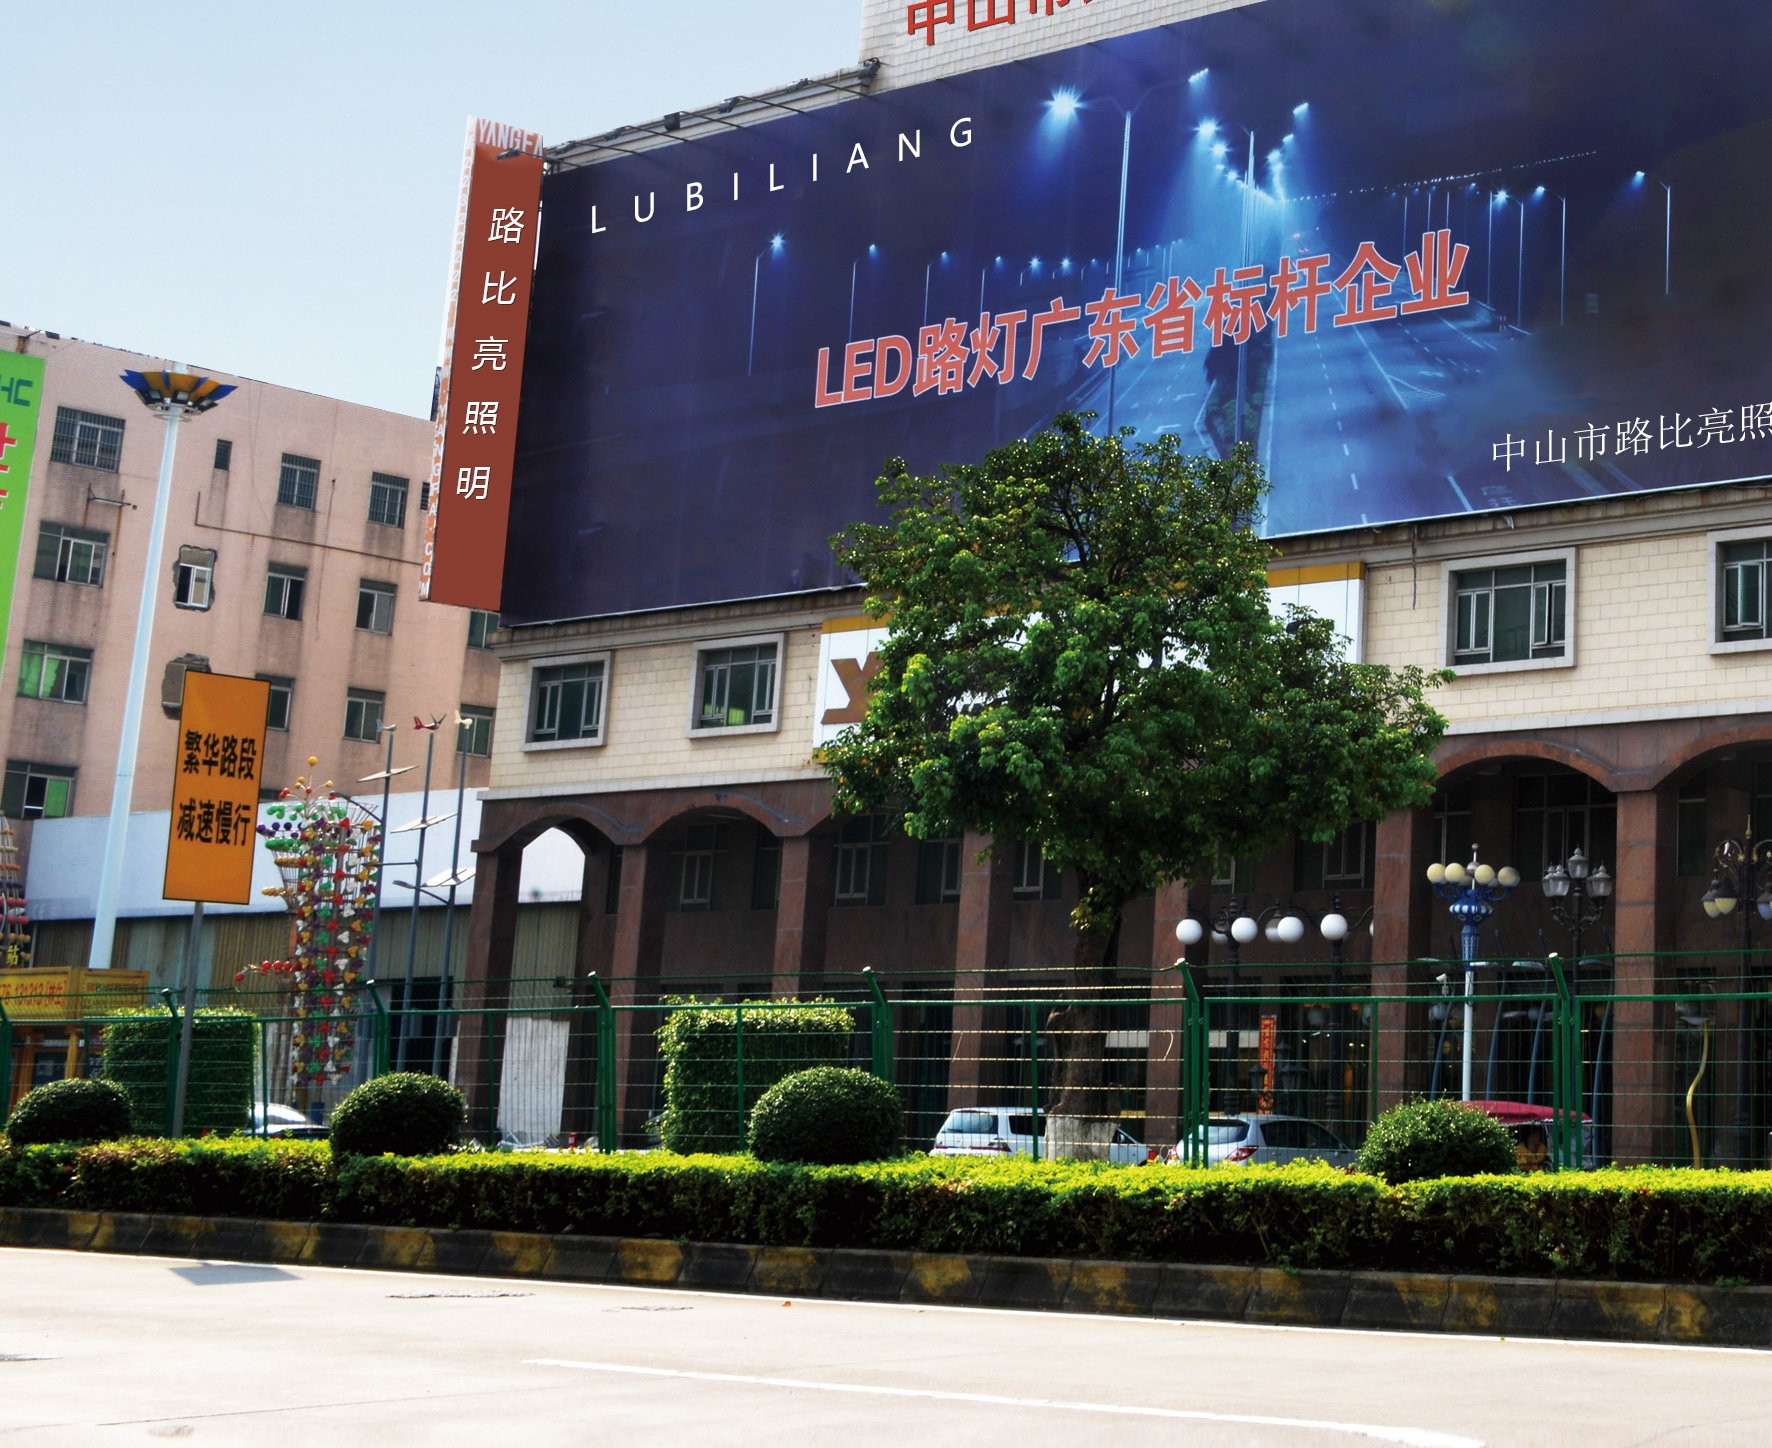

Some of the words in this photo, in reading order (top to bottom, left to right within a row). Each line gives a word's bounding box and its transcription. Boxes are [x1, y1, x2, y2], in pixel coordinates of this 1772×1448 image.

[590, 117, 974, 234] LUBILIANG
[455, 205, 526, 501] 路比亮照明
[814, 228, 1470, 409] LED路灯广东省标杆企业
[183, 729, 257, 781] 繁华路段
[177, 797, 251, 847] 减速慢行
